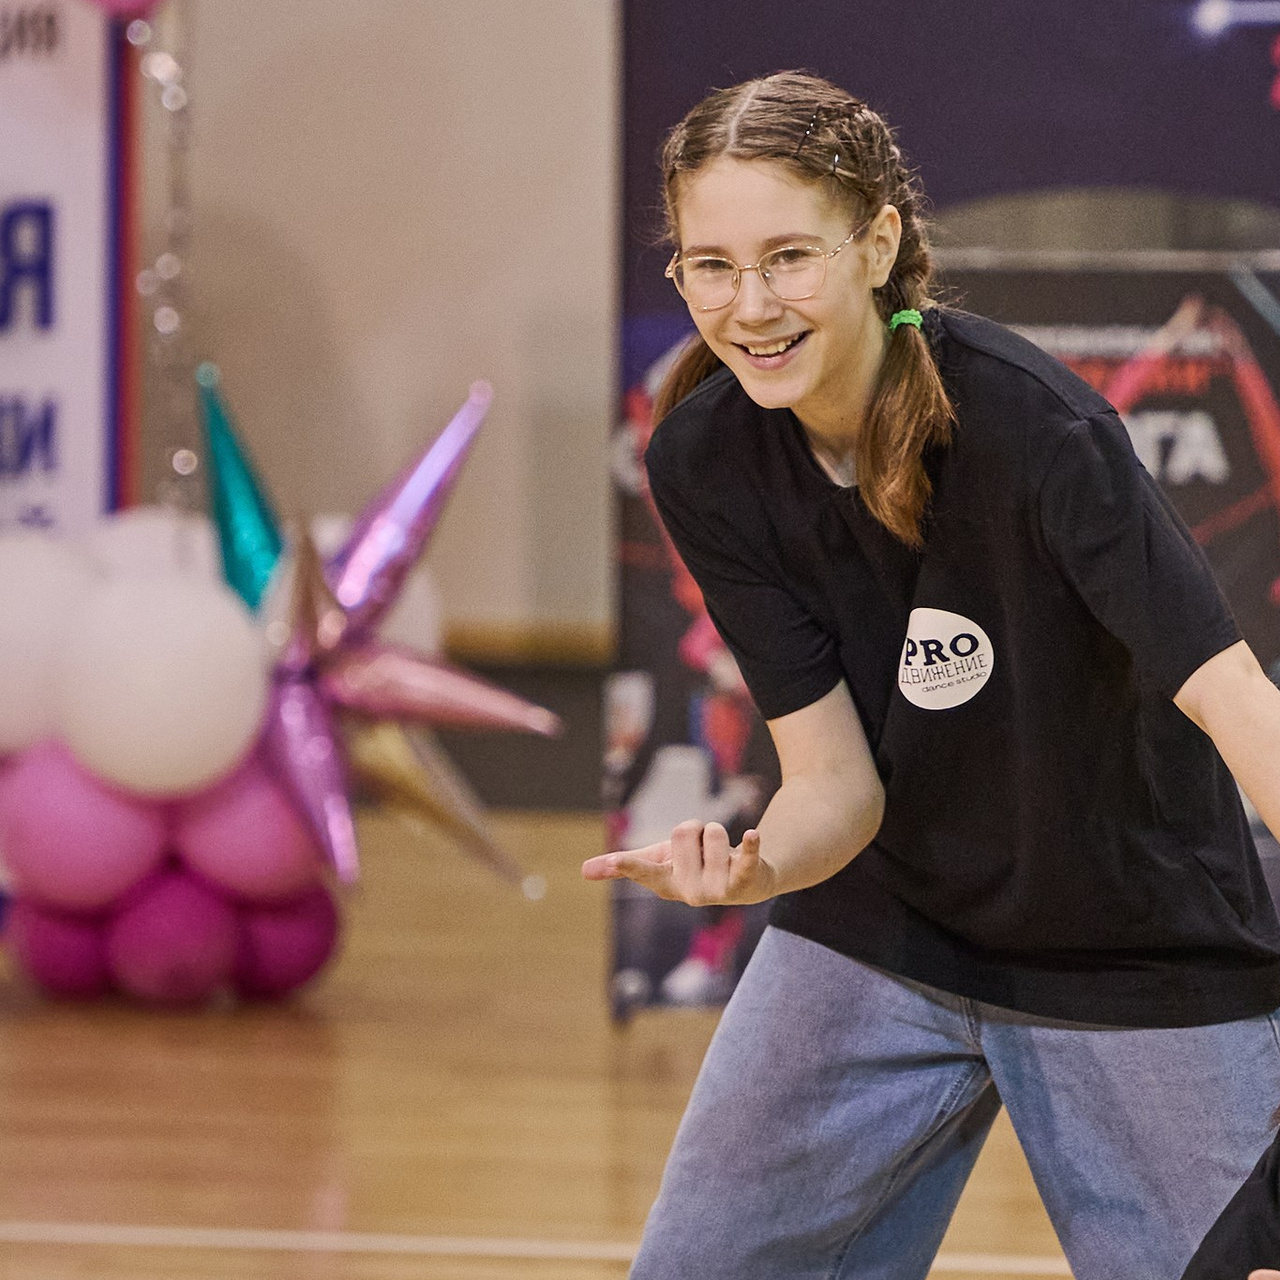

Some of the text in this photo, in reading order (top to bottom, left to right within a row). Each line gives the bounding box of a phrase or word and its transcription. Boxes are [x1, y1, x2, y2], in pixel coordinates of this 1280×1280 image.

[905, 633, 979, 666] PRO
[901, 653, 988, 686] ДВИЖЕНИЕ
[921, 680, 955, 693] dance
